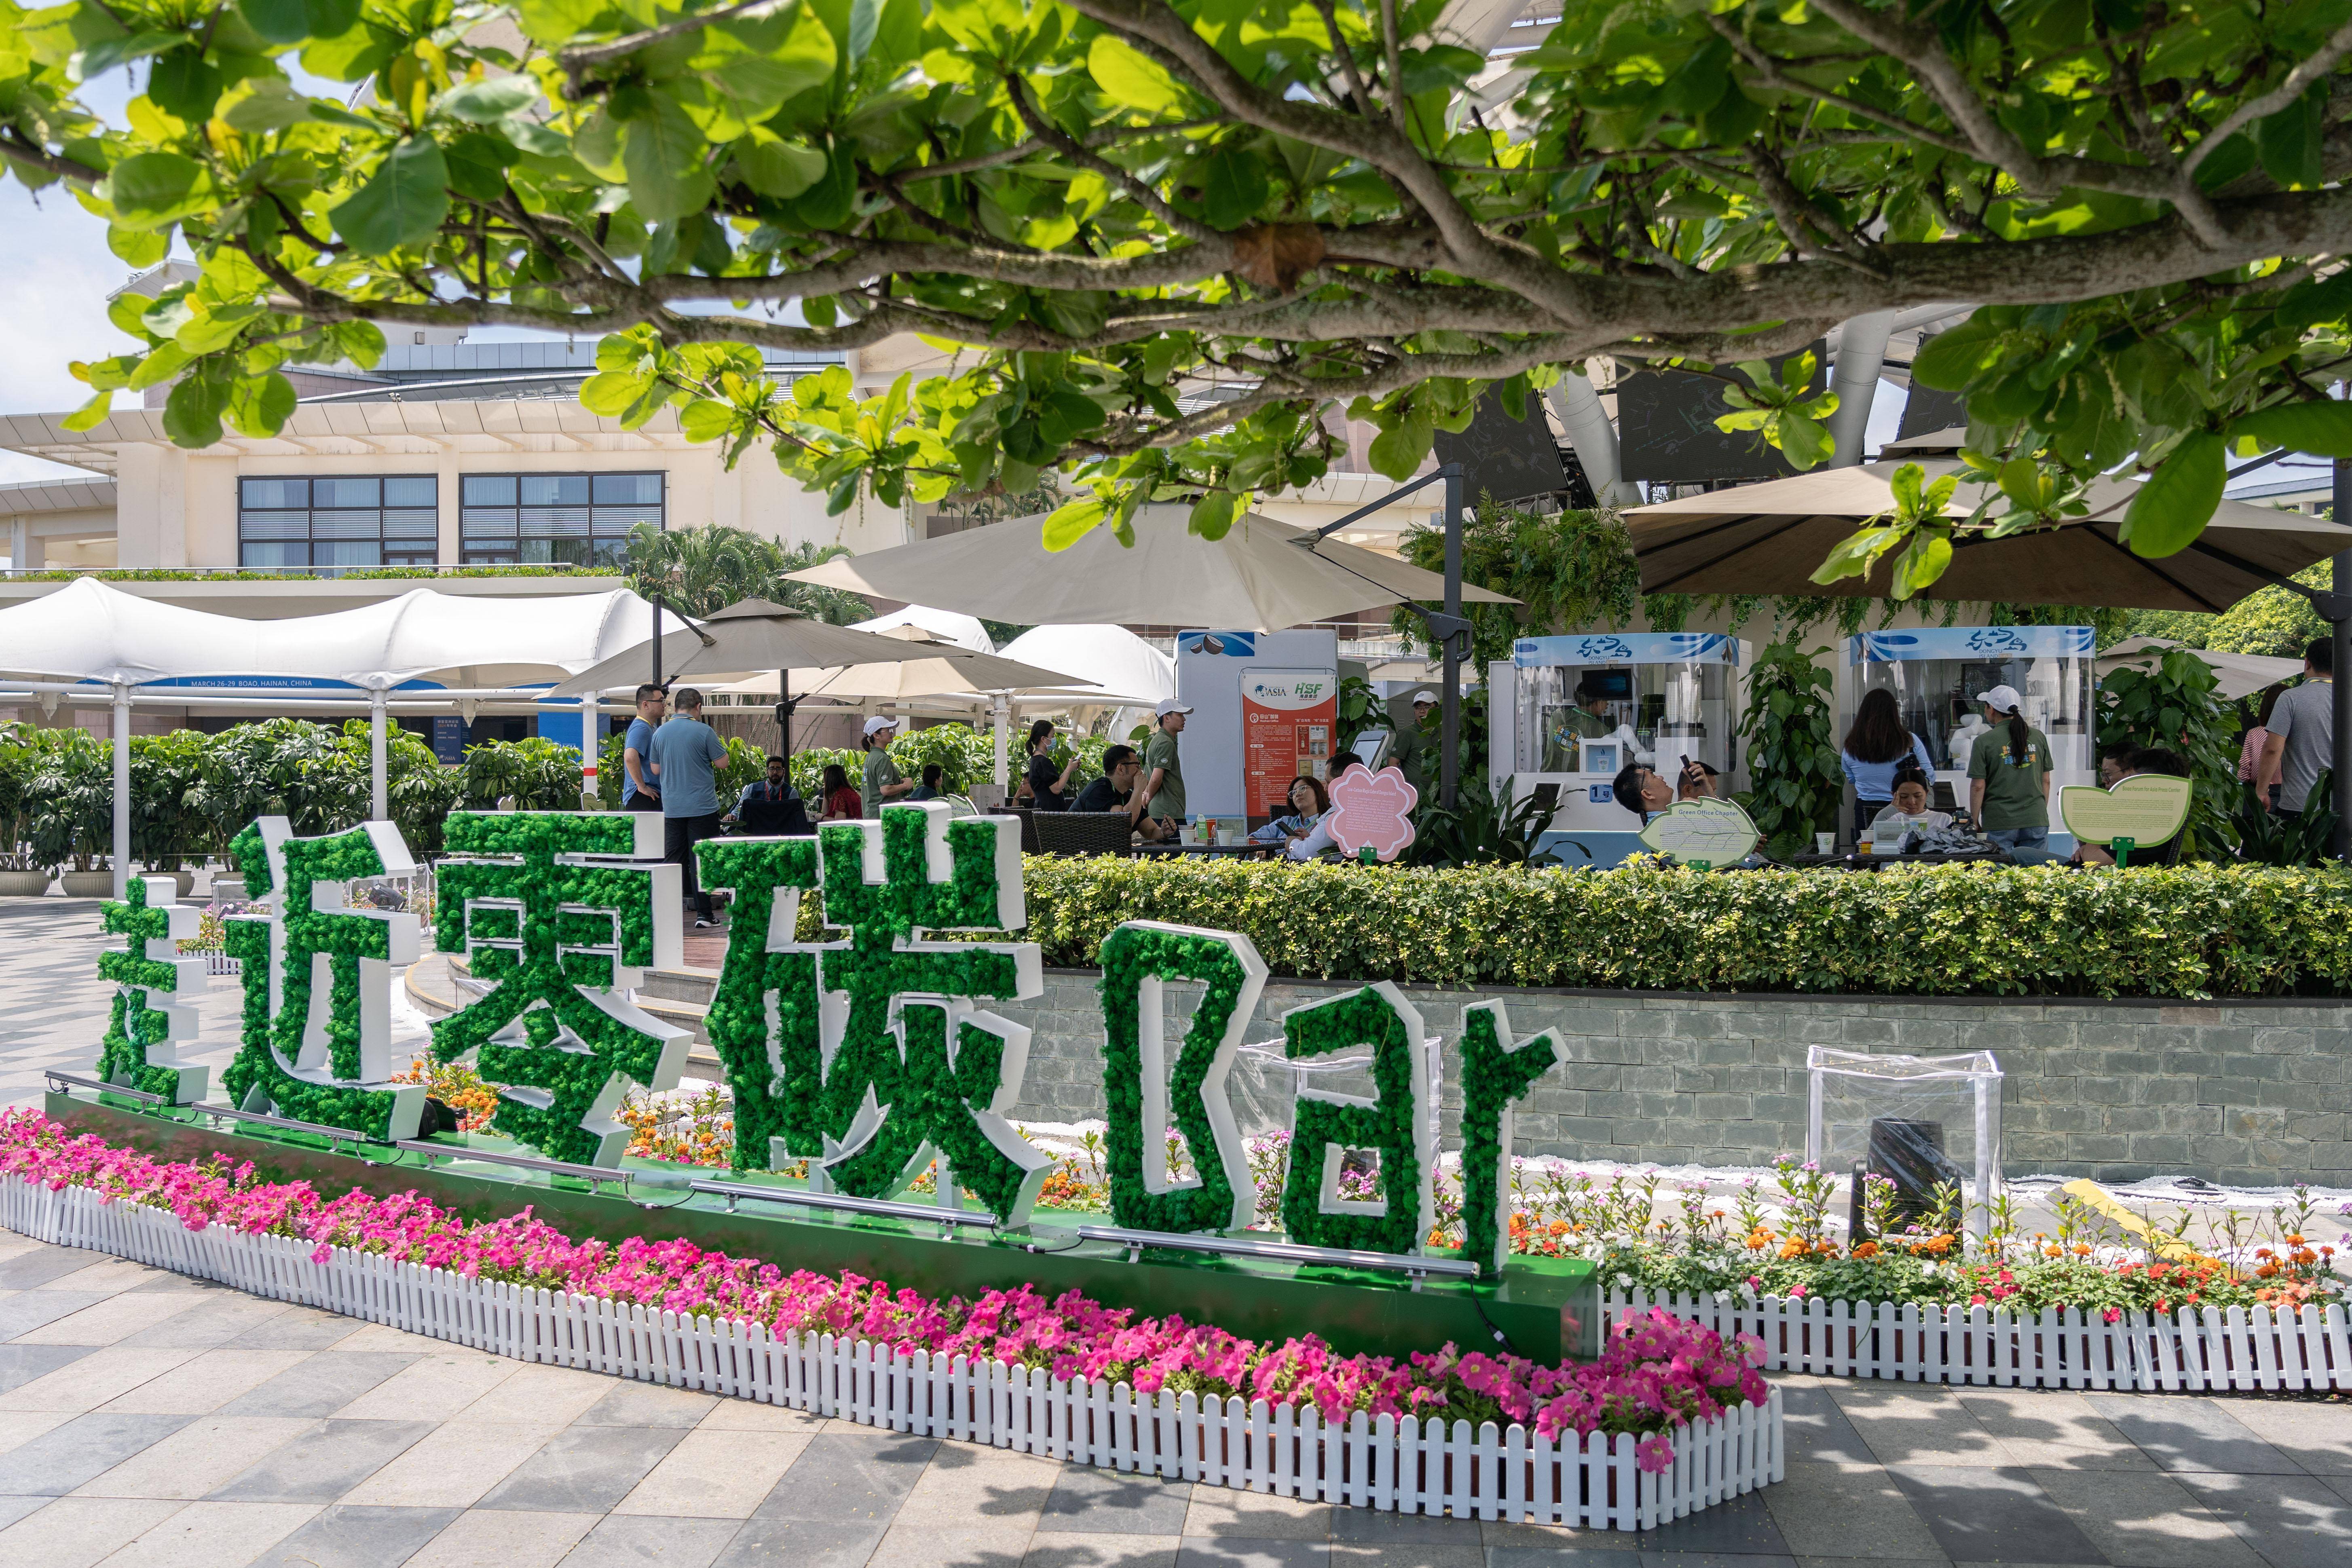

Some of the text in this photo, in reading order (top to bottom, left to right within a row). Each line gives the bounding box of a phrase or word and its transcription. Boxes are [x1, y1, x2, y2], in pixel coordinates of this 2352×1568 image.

[1267, 688, 1287, 696] ASIA
[1295, 683, 1323, 694] HSF
[1098, 920, 1572, 1276] Bar
